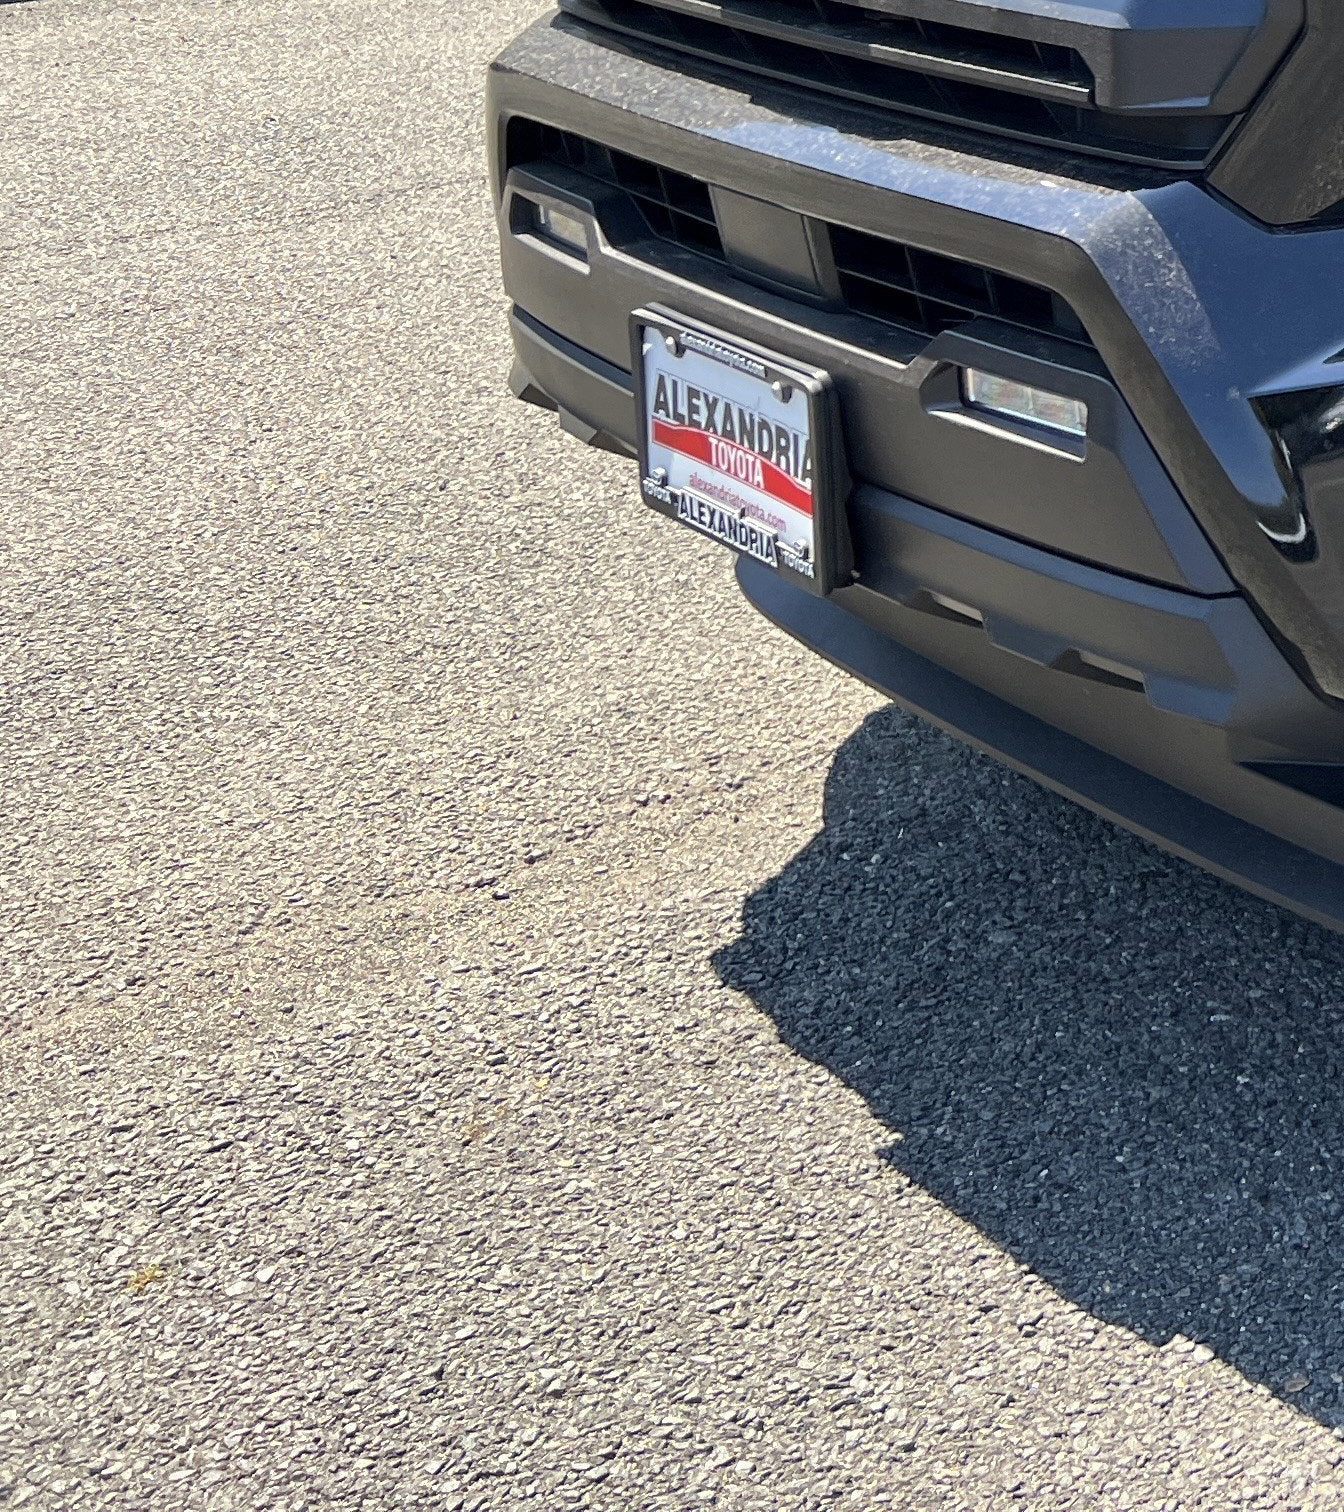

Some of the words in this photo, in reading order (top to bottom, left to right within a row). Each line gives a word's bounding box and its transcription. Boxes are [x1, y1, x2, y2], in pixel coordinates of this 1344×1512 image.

[653, 374, 812, 485] ALEXANDRIA
[708, 437, 765, 489] TOYOTA
[677, 489, 778, 568] ALEXANDRIA
